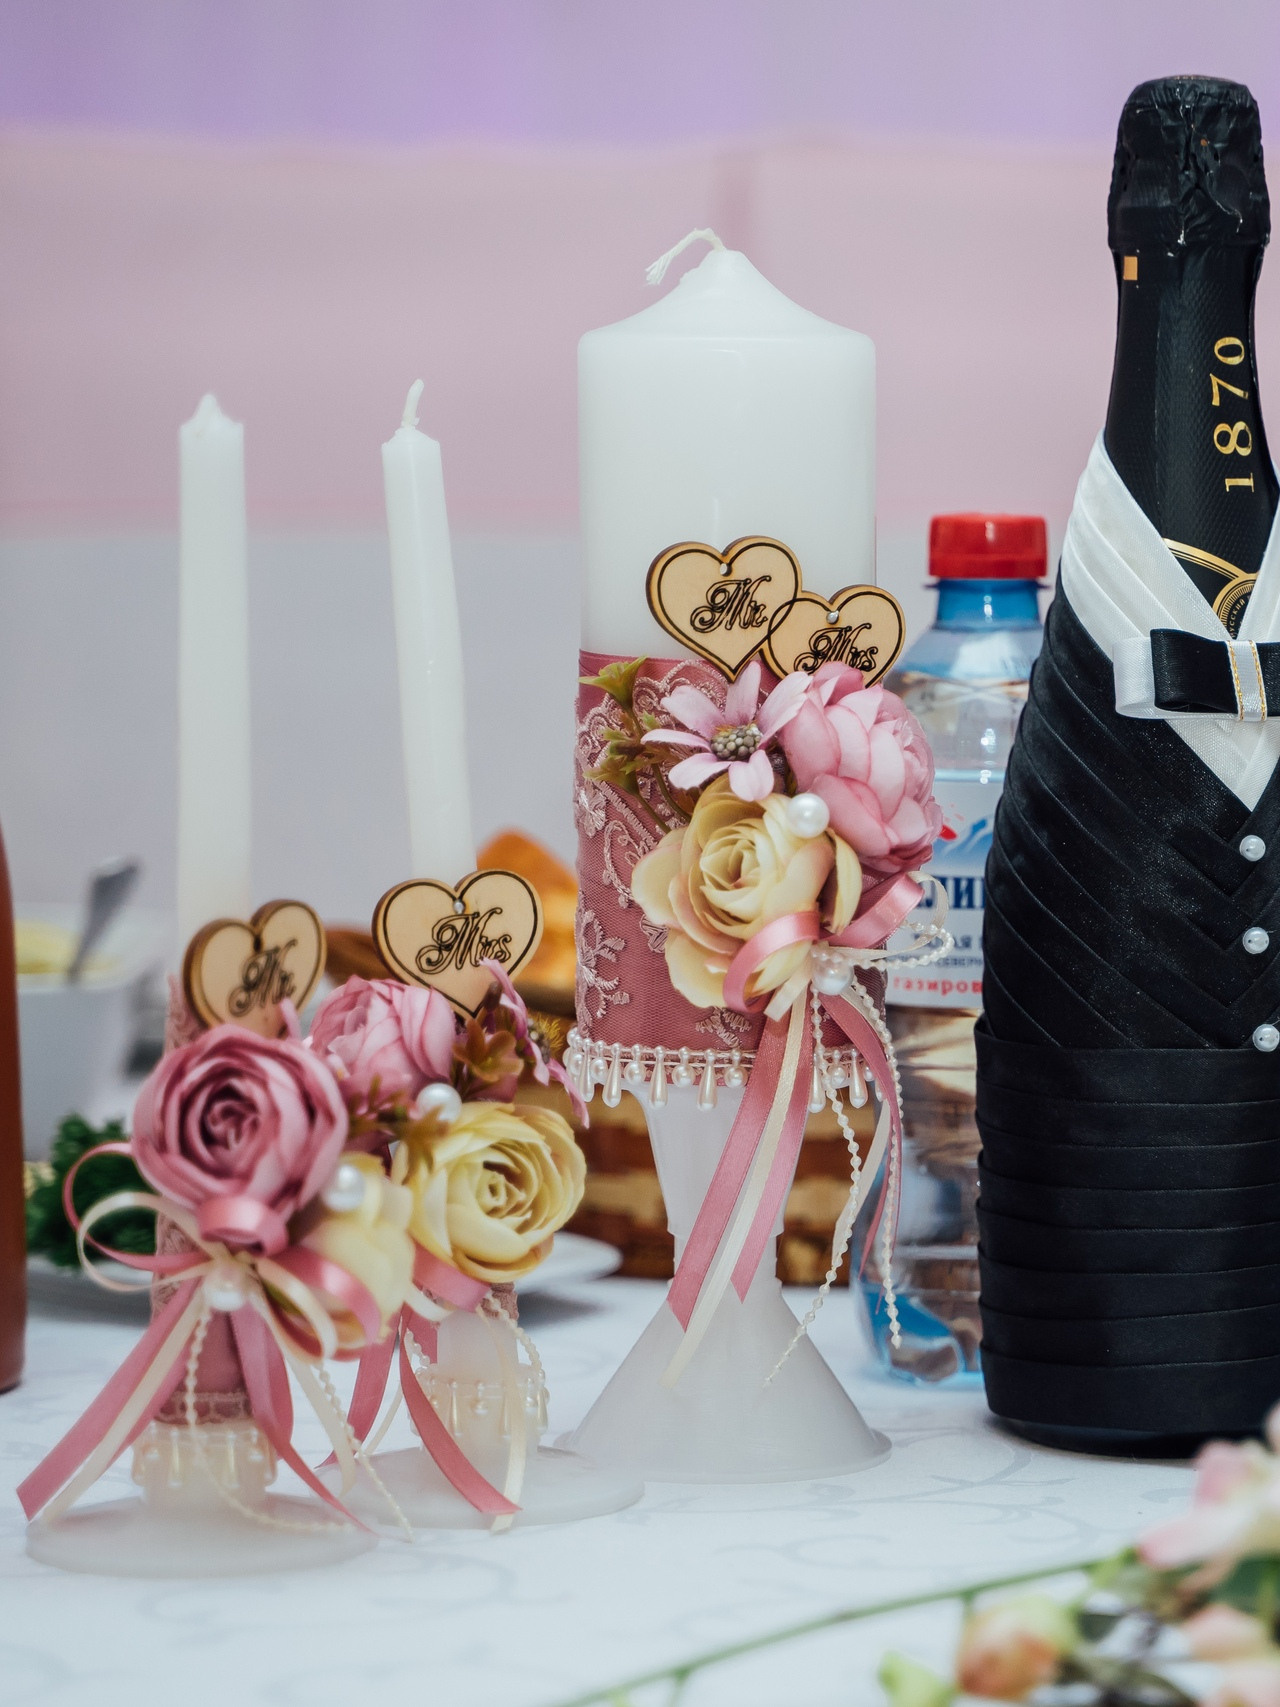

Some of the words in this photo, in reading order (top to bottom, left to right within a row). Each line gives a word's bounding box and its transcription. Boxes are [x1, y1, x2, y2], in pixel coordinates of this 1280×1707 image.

[1209, 336, 1255, 493] 1870
[690, 575, 772, 634] Mr
[794, 622, 878, 674] Mrs
[415, 906, 512, 975] Mrs
